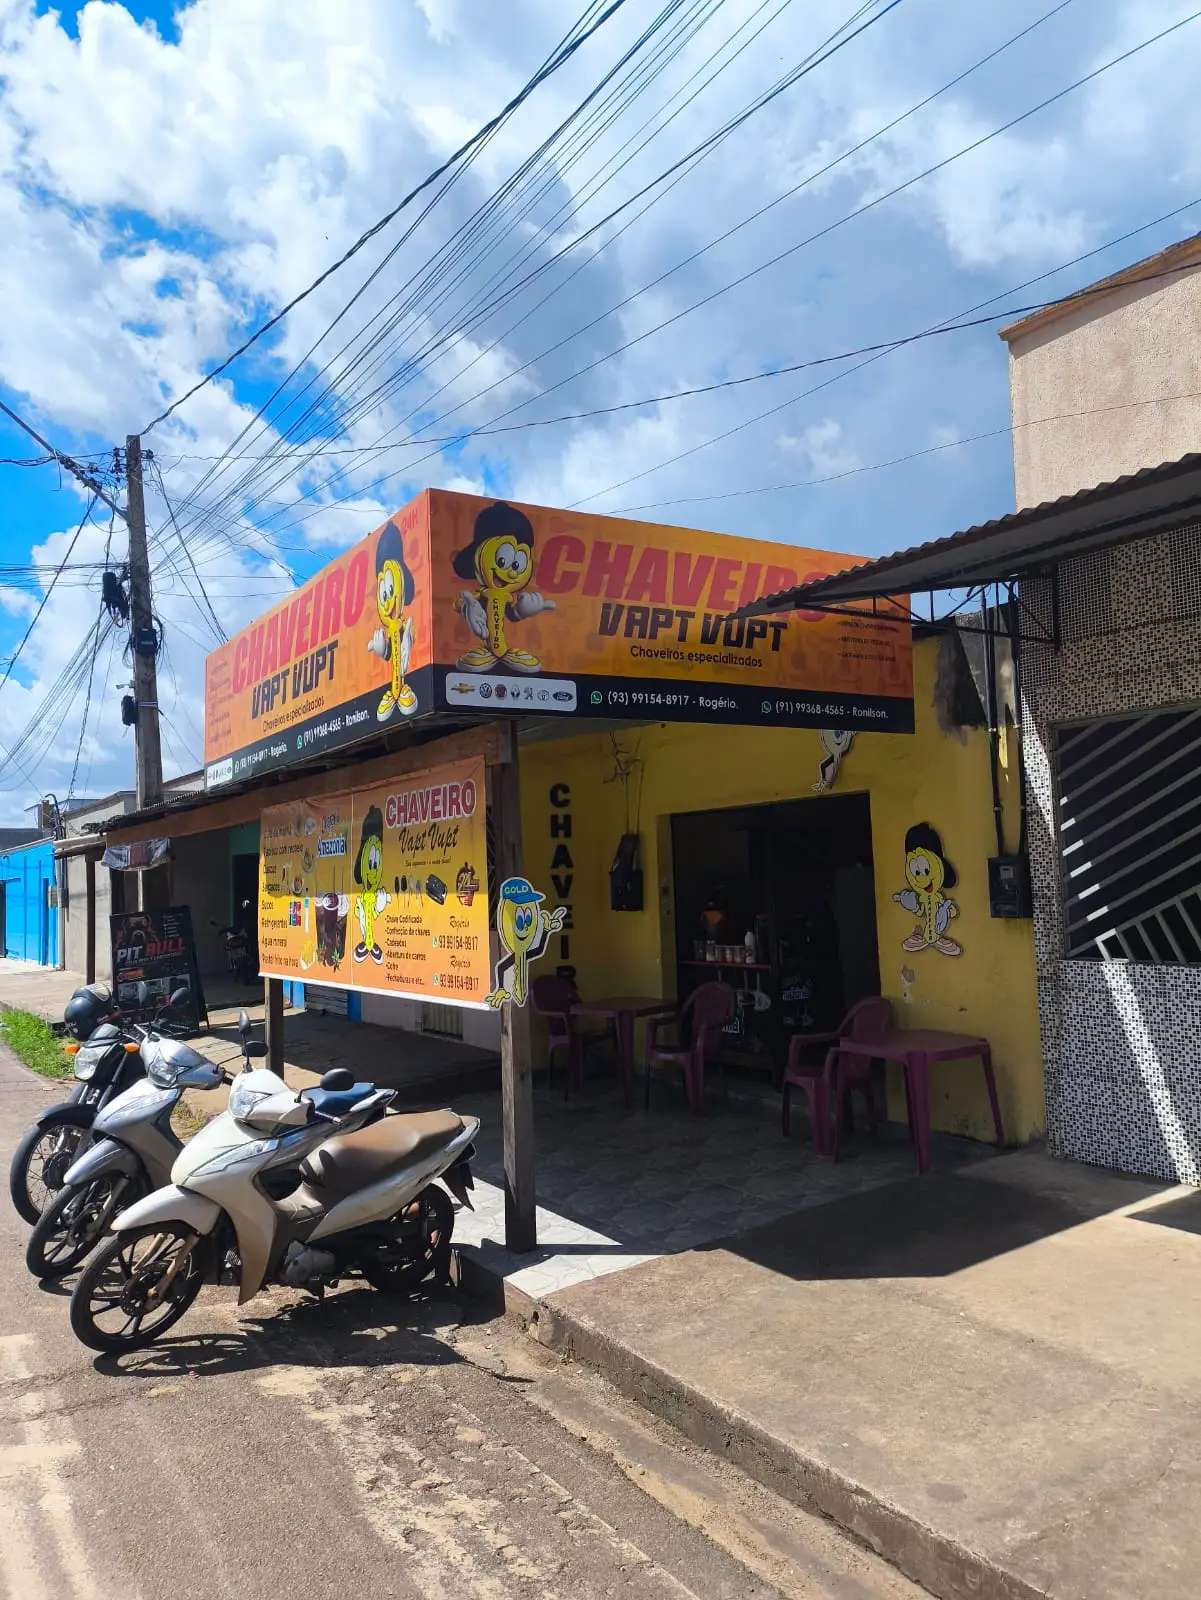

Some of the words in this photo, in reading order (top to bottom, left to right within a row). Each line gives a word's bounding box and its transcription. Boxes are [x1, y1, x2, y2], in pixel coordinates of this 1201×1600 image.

[232, 550, 370, 695] CHAVEIRO
[599, 603, 696, 643] VAPT
[700, 612, 788, 652] VUPT
[630, 645, 685, 661] Chaveiros
[687, 653, 763, 669] especializados
[251, 668, 291, 720] VAPT
[292, 640, 339, 700] VUPT
[607, 691, 629, 706] (93)
[631, 692, 690, 706] 99154-8917
[775, 700, 794, 714] (91)
[795, 702, 845, 717] 99368-4565
[852, 706, 889, 719] Ronilson.
[385, 779, 477, 829] CHAVEIRO
[399, 826, 427, 859] Vapt
[428, 822, 460, 857] Vupt
[503, 885, 530, 896] GOLD
[117, 945, 143, 962] PIT
[145, 937, 186, 958] BULL
